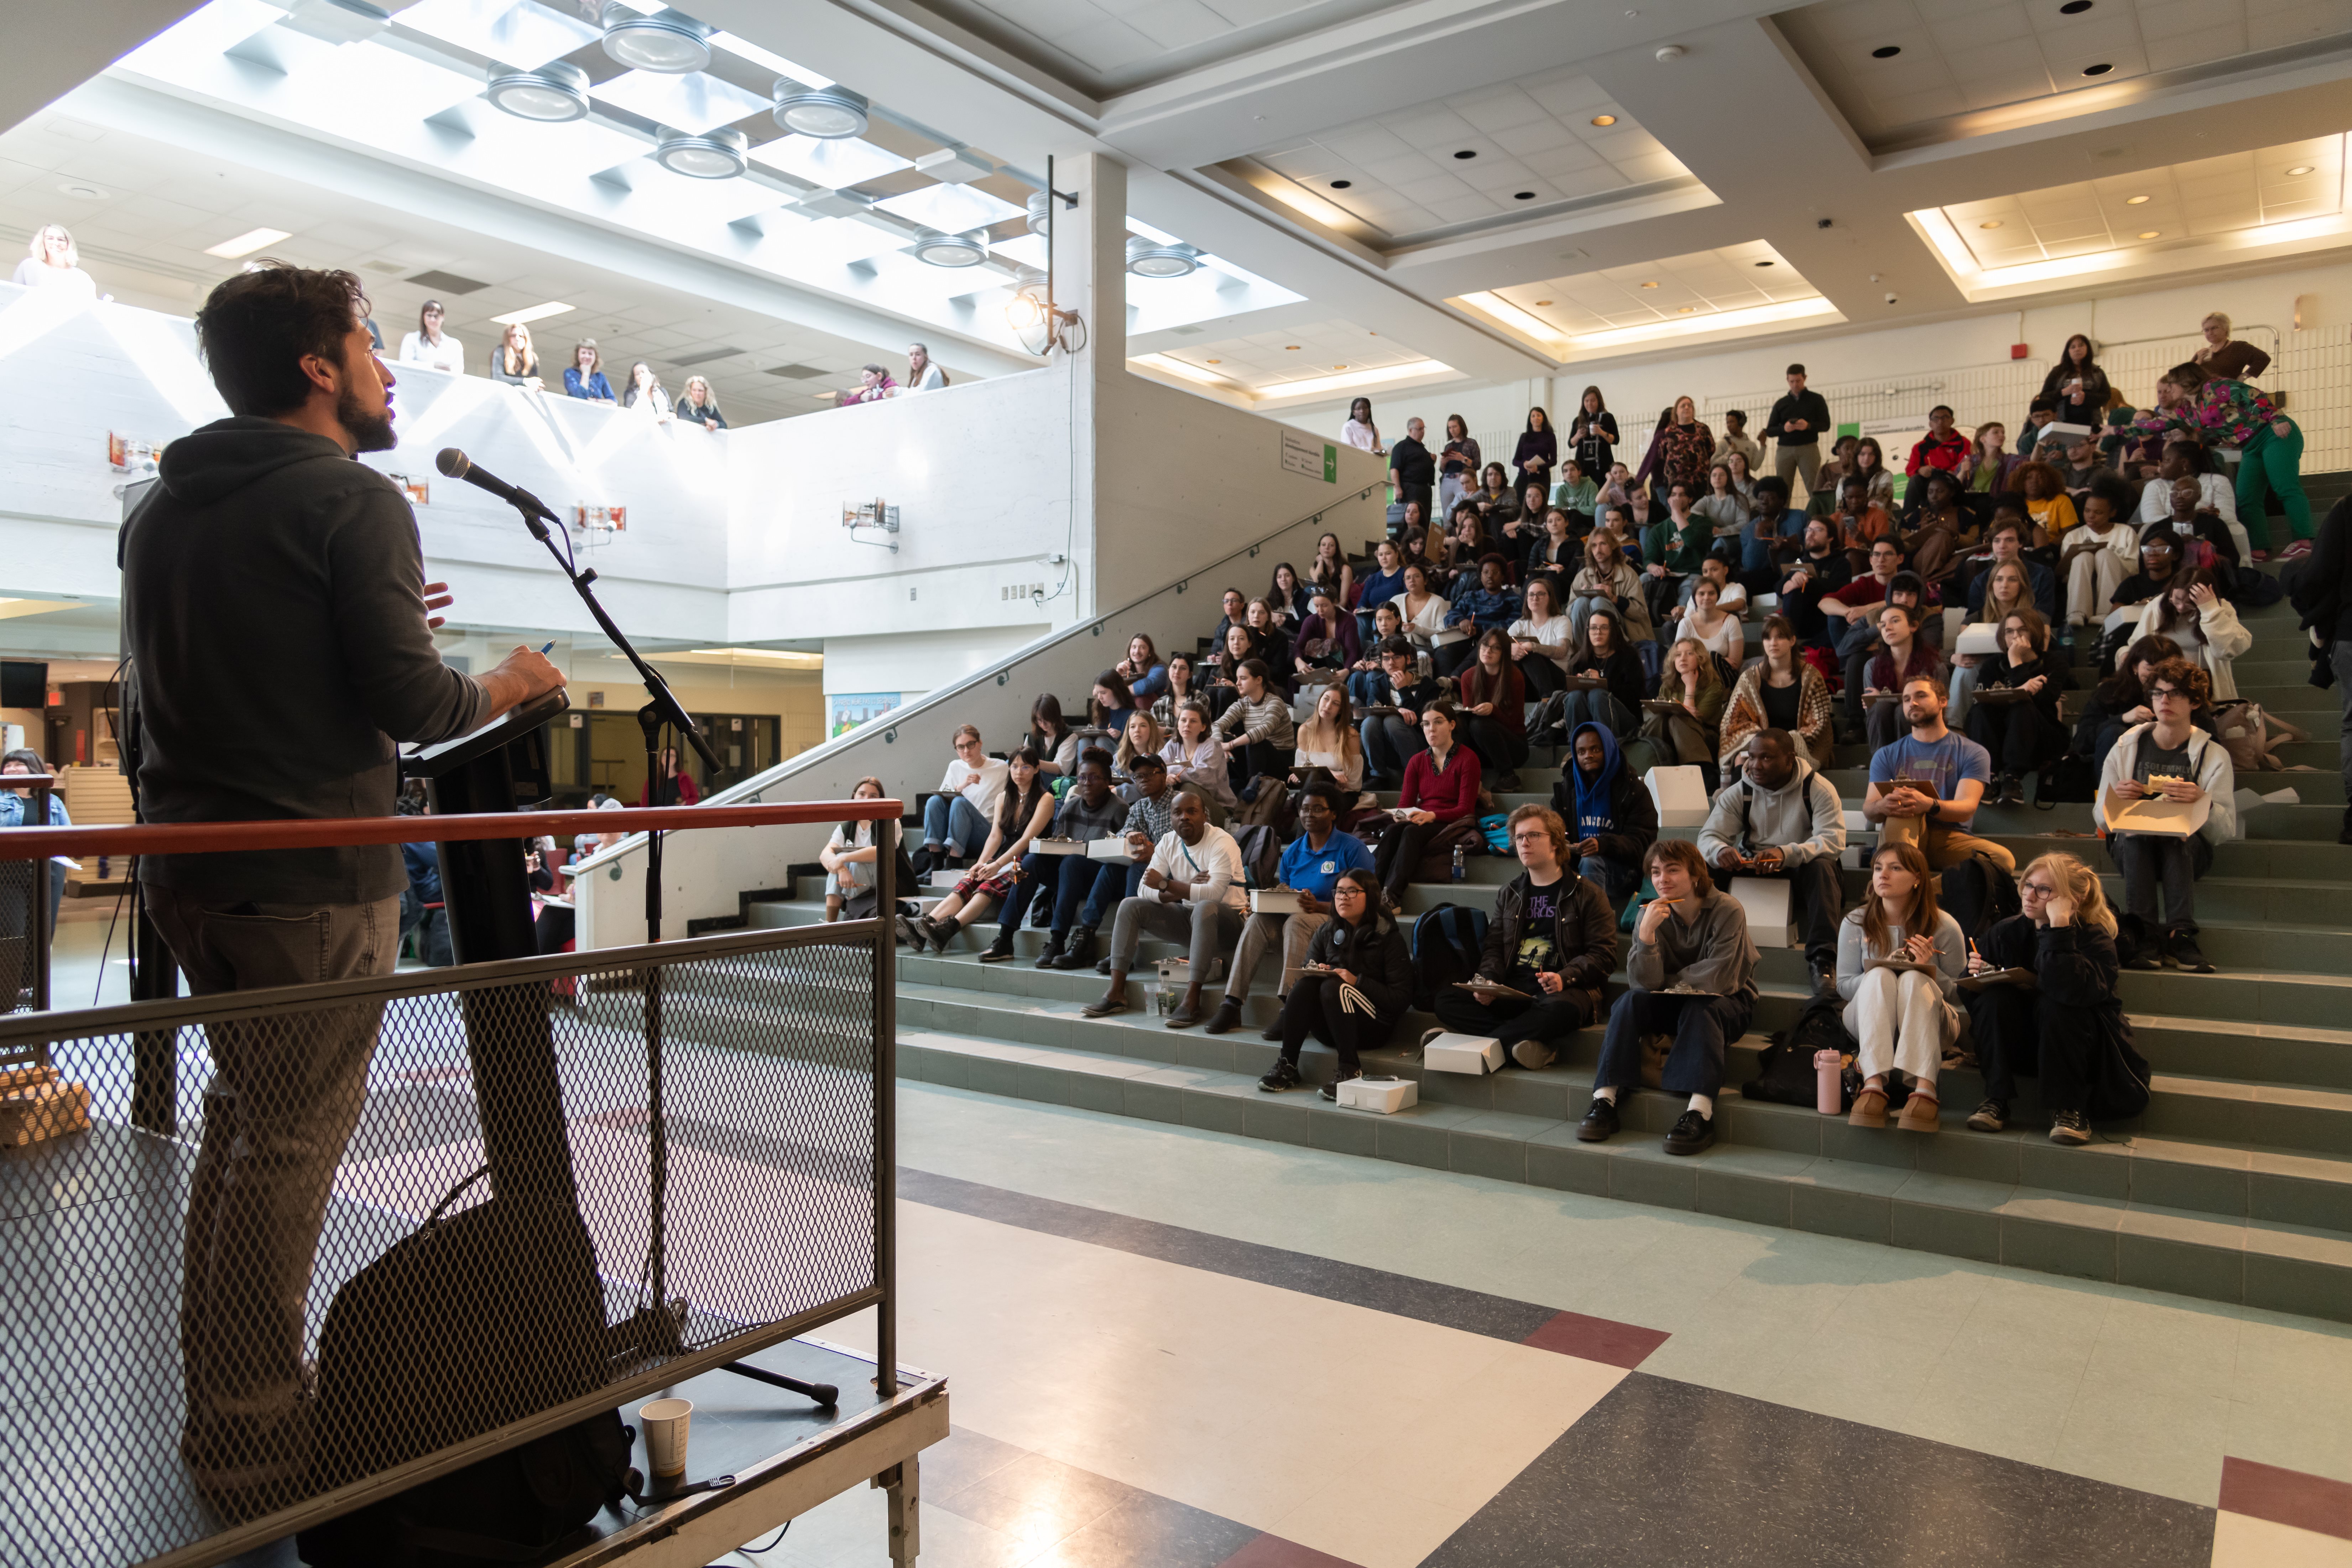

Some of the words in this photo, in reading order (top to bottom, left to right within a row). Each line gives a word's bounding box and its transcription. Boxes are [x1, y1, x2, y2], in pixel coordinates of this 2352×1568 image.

[2144, 761, 2191, 773] SOLEMNLY
[1529, 895, 1549, 907] THE
[1526, 906, 1556, 919] ORCIS
